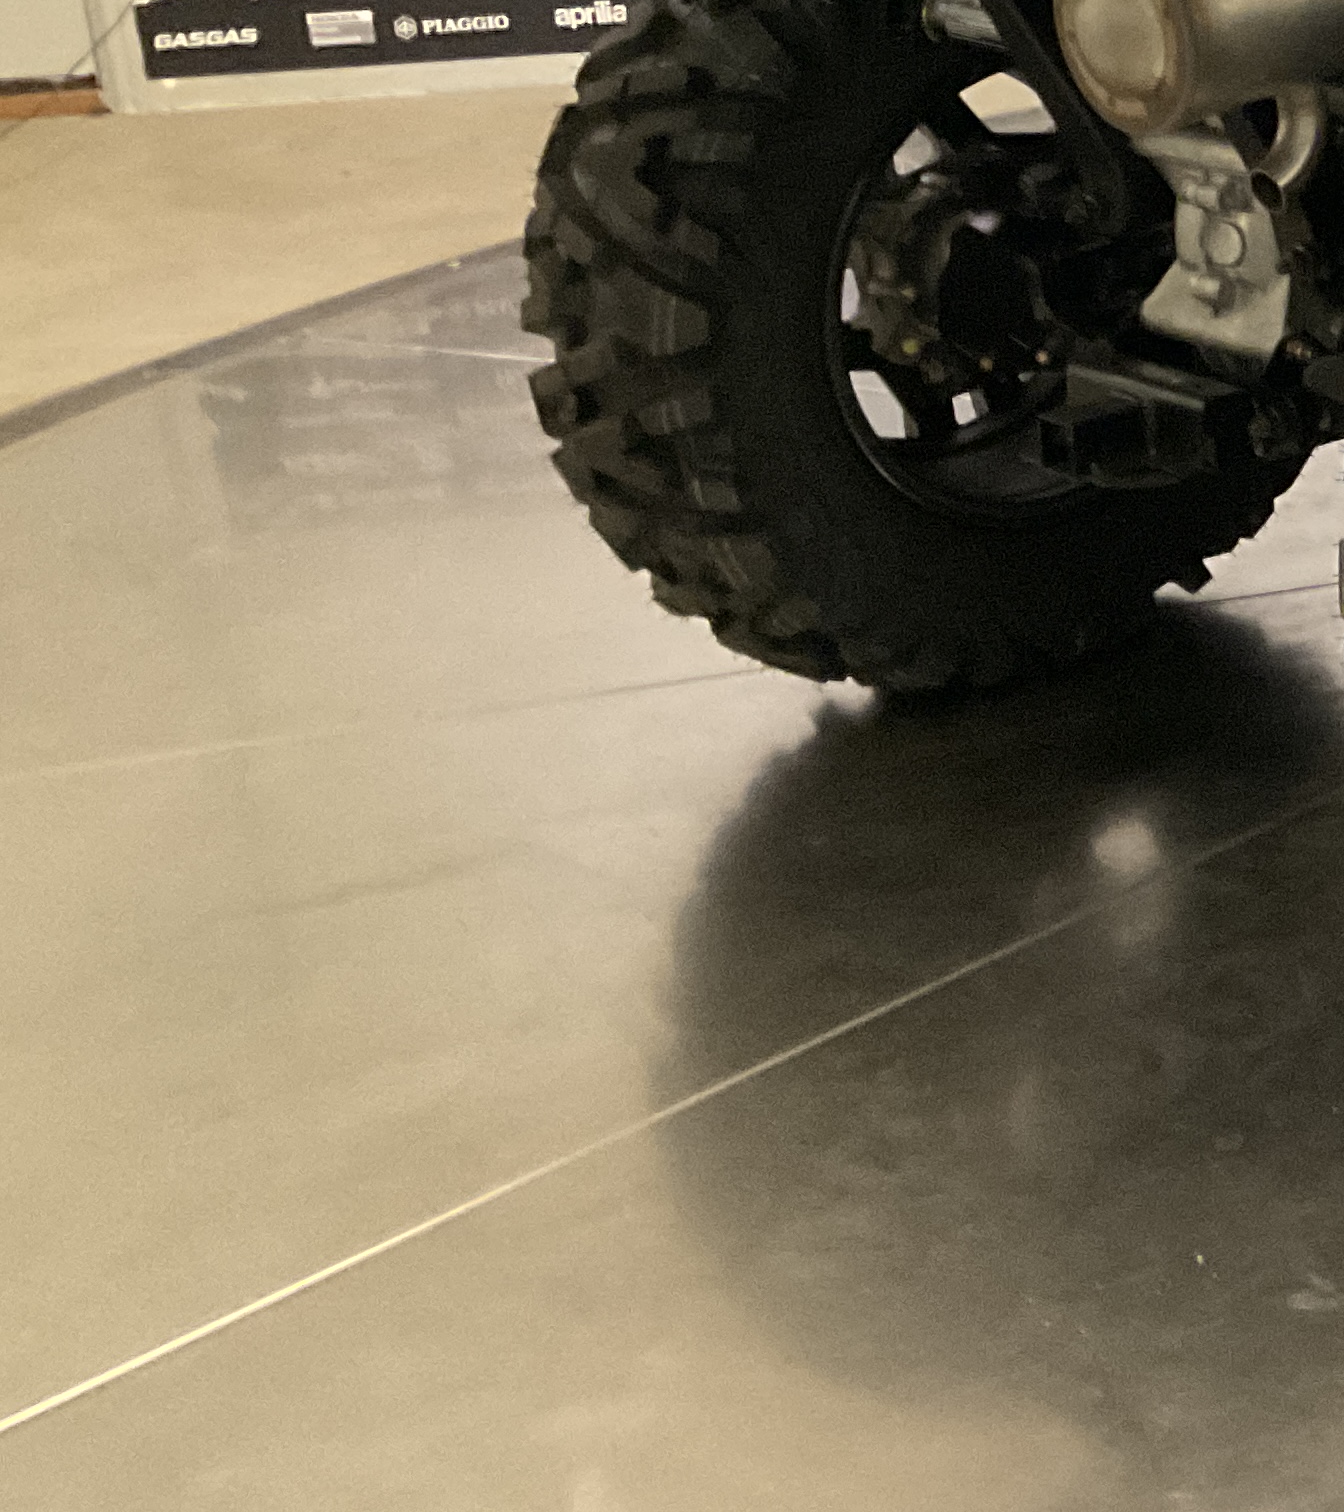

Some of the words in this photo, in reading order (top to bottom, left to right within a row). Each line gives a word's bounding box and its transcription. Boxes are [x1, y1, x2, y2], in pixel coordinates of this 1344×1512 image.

[422, 14, 509, 34] PIAGGIO
[555, 0, 627, 29] aprilia
[154, 28, 257, 50] GASGAS
